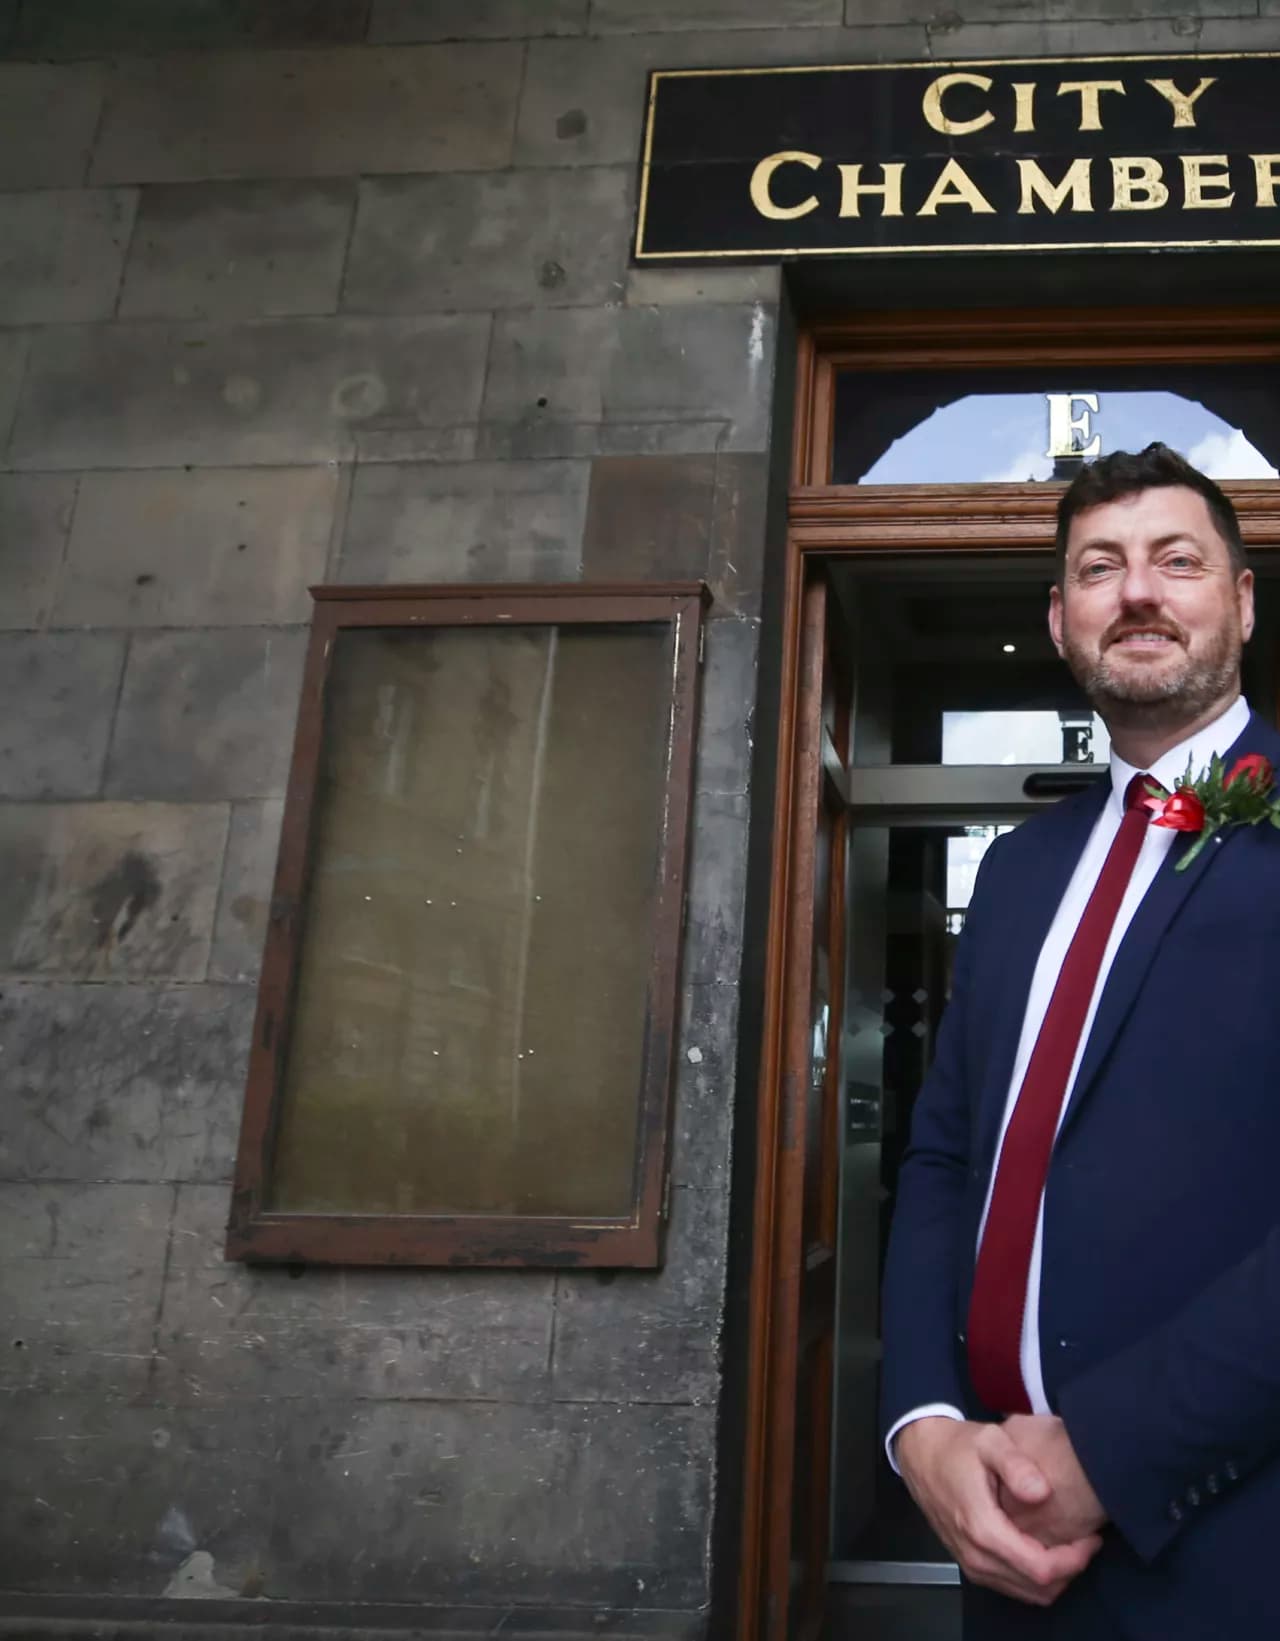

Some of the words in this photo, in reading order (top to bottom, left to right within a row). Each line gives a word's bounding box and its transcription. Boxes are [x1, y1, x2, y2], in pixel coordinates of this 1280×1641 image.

[922, 72, 1219, 136] CITY
[1045, 392, 1102, 458] E
[1061, 726, 1094, 763] E
